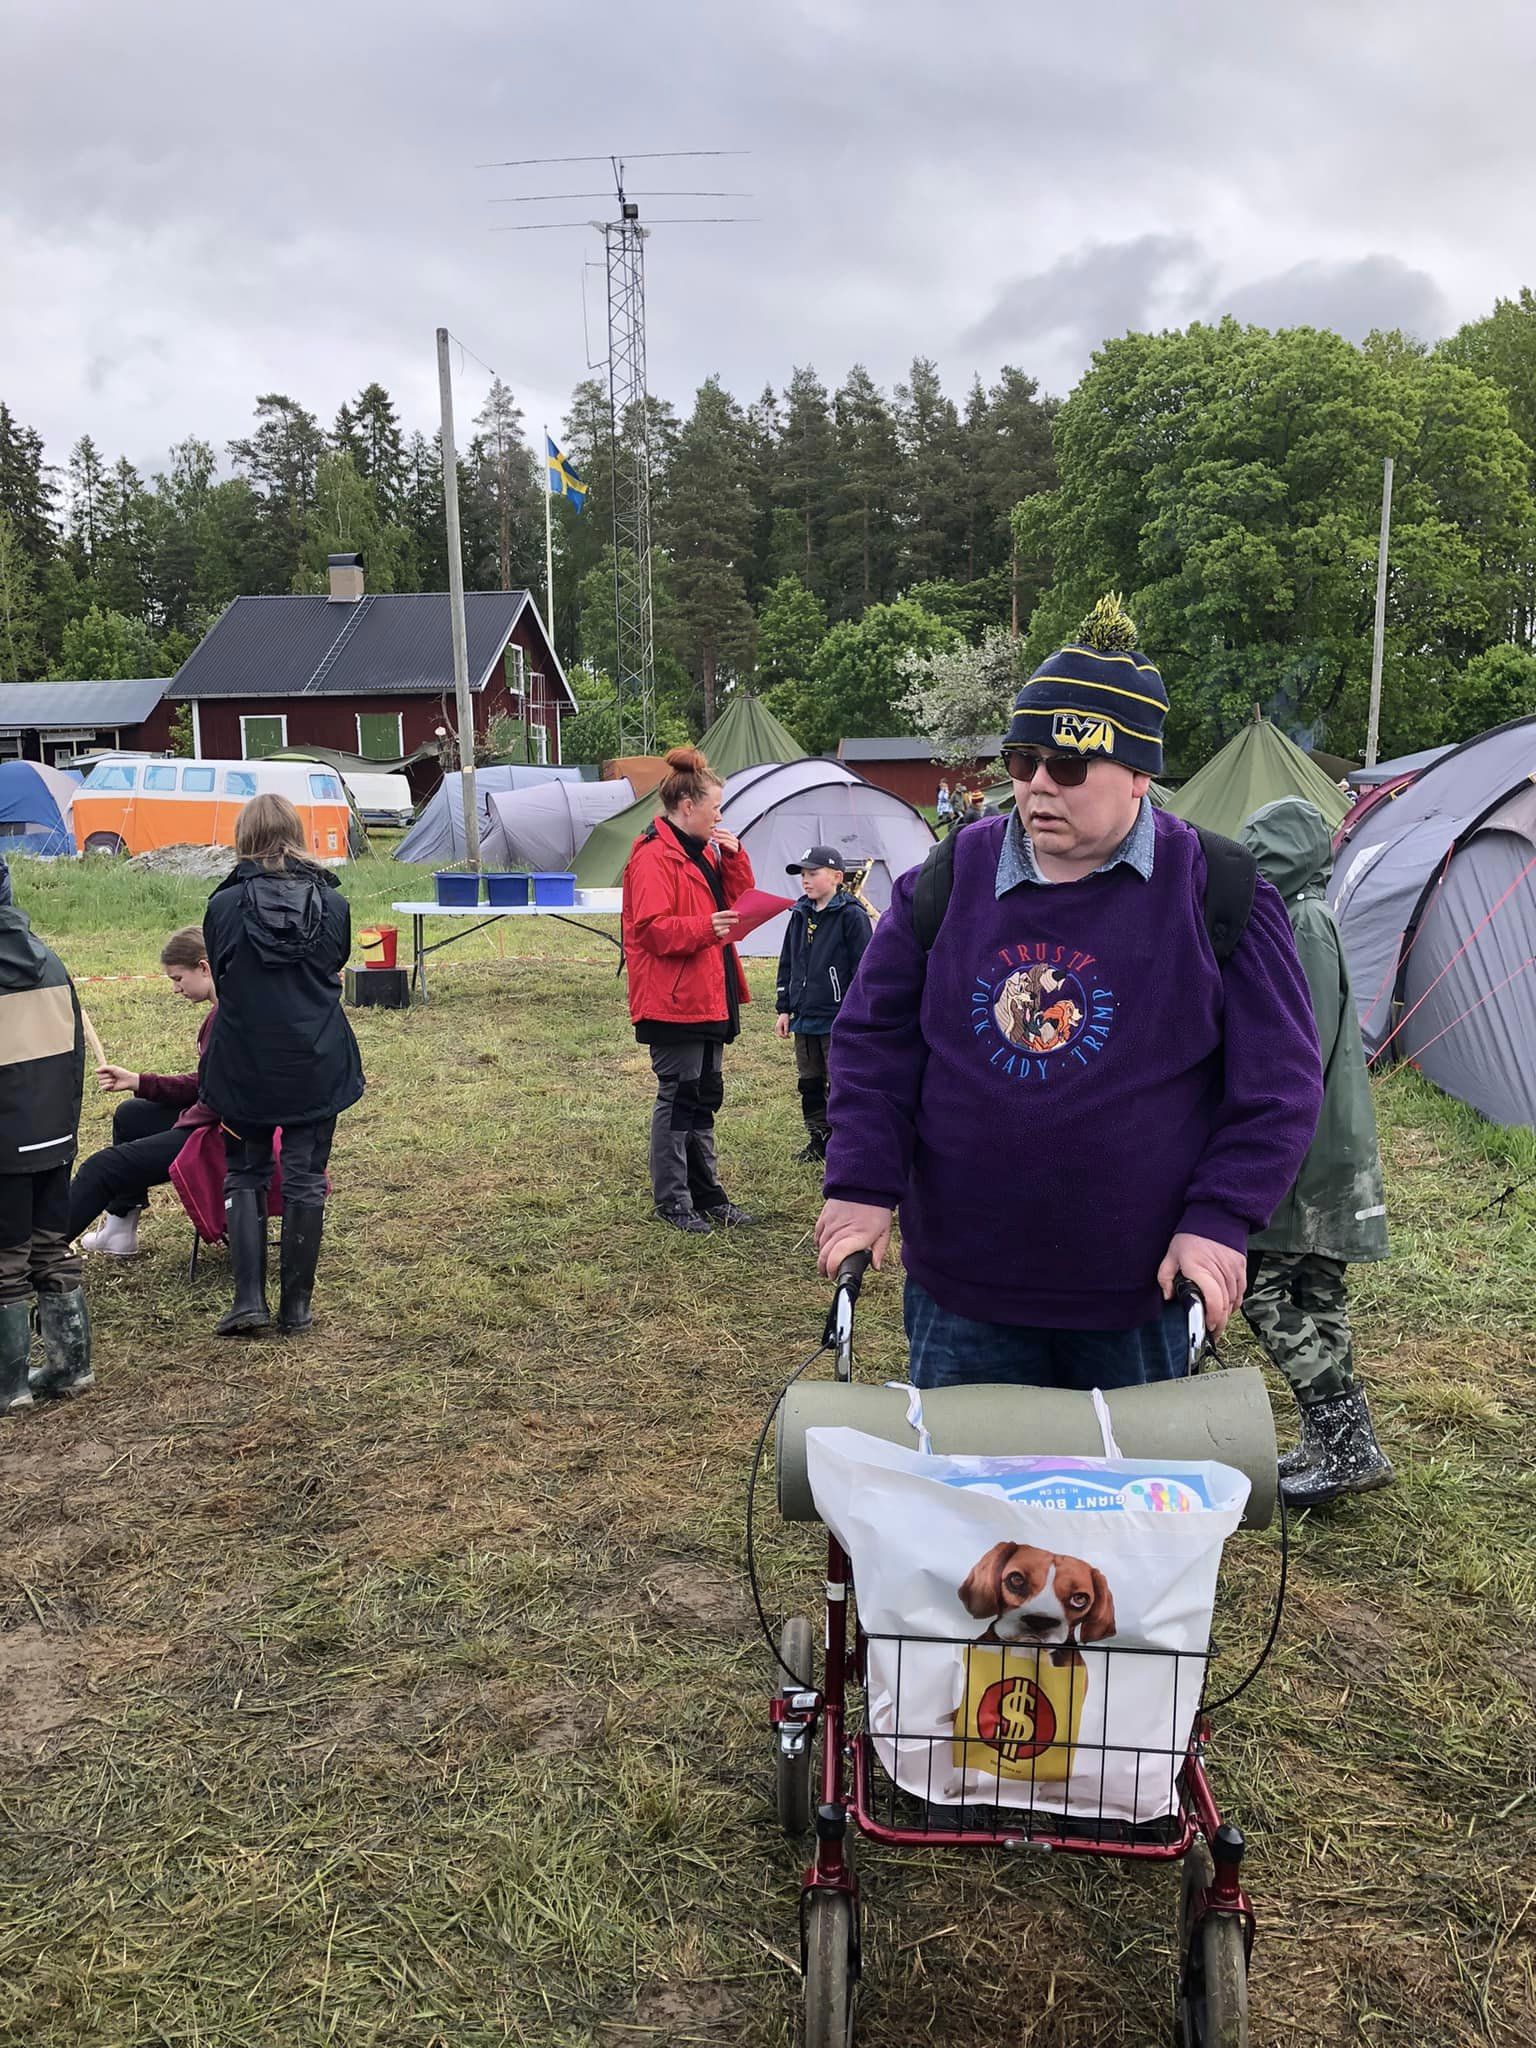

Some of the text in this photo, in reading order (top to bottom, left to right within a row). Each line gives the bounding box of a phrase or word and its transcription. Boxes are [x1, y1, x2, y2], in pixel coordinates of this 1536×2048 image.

[1054, 713, 1110, 748] HV71
[998, 942, 1097, 972] TRUSTY
[971, 975, 992, 1036] JOCK
[1070, 988, 1115, 1066] TRAMP
[990, 1047, 1050, 1081] LADY
[1075, 1494, 1126, 1509] GIANT
